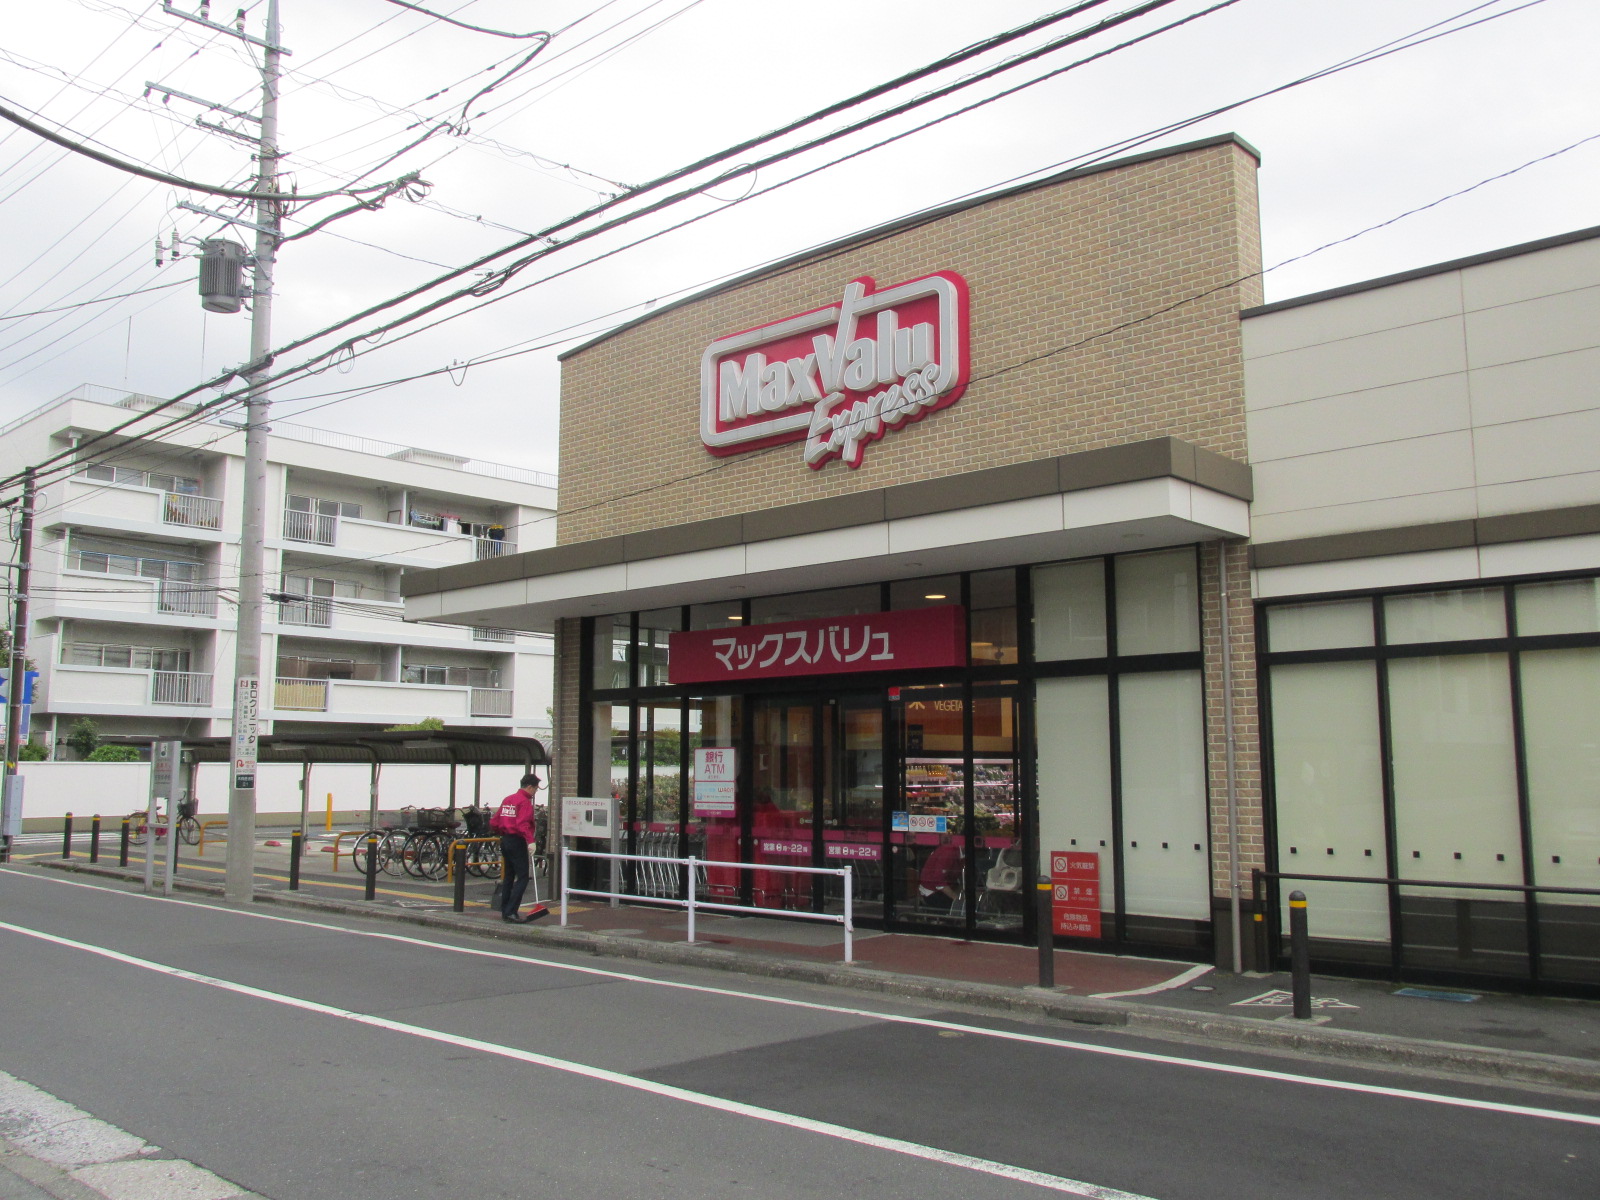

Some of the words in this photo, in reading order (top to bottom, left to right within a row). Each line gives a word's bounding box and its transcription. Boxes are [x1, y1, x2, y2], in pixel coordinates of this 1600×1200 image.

[719, 282, 935, 422] MaxValu
[804, 363, 941, 464] Express
[712, 625, 894, 672] マックスバリュ
[248, 680, 258, 744] 野口クリニック
[704, 763, 725, 775] ATM
[705, 751, 723, 763] 銀行
[1069, 862, 1095, 870] 火気厳禁
[1060, 922, 1092, 932] 持込み厳禁
